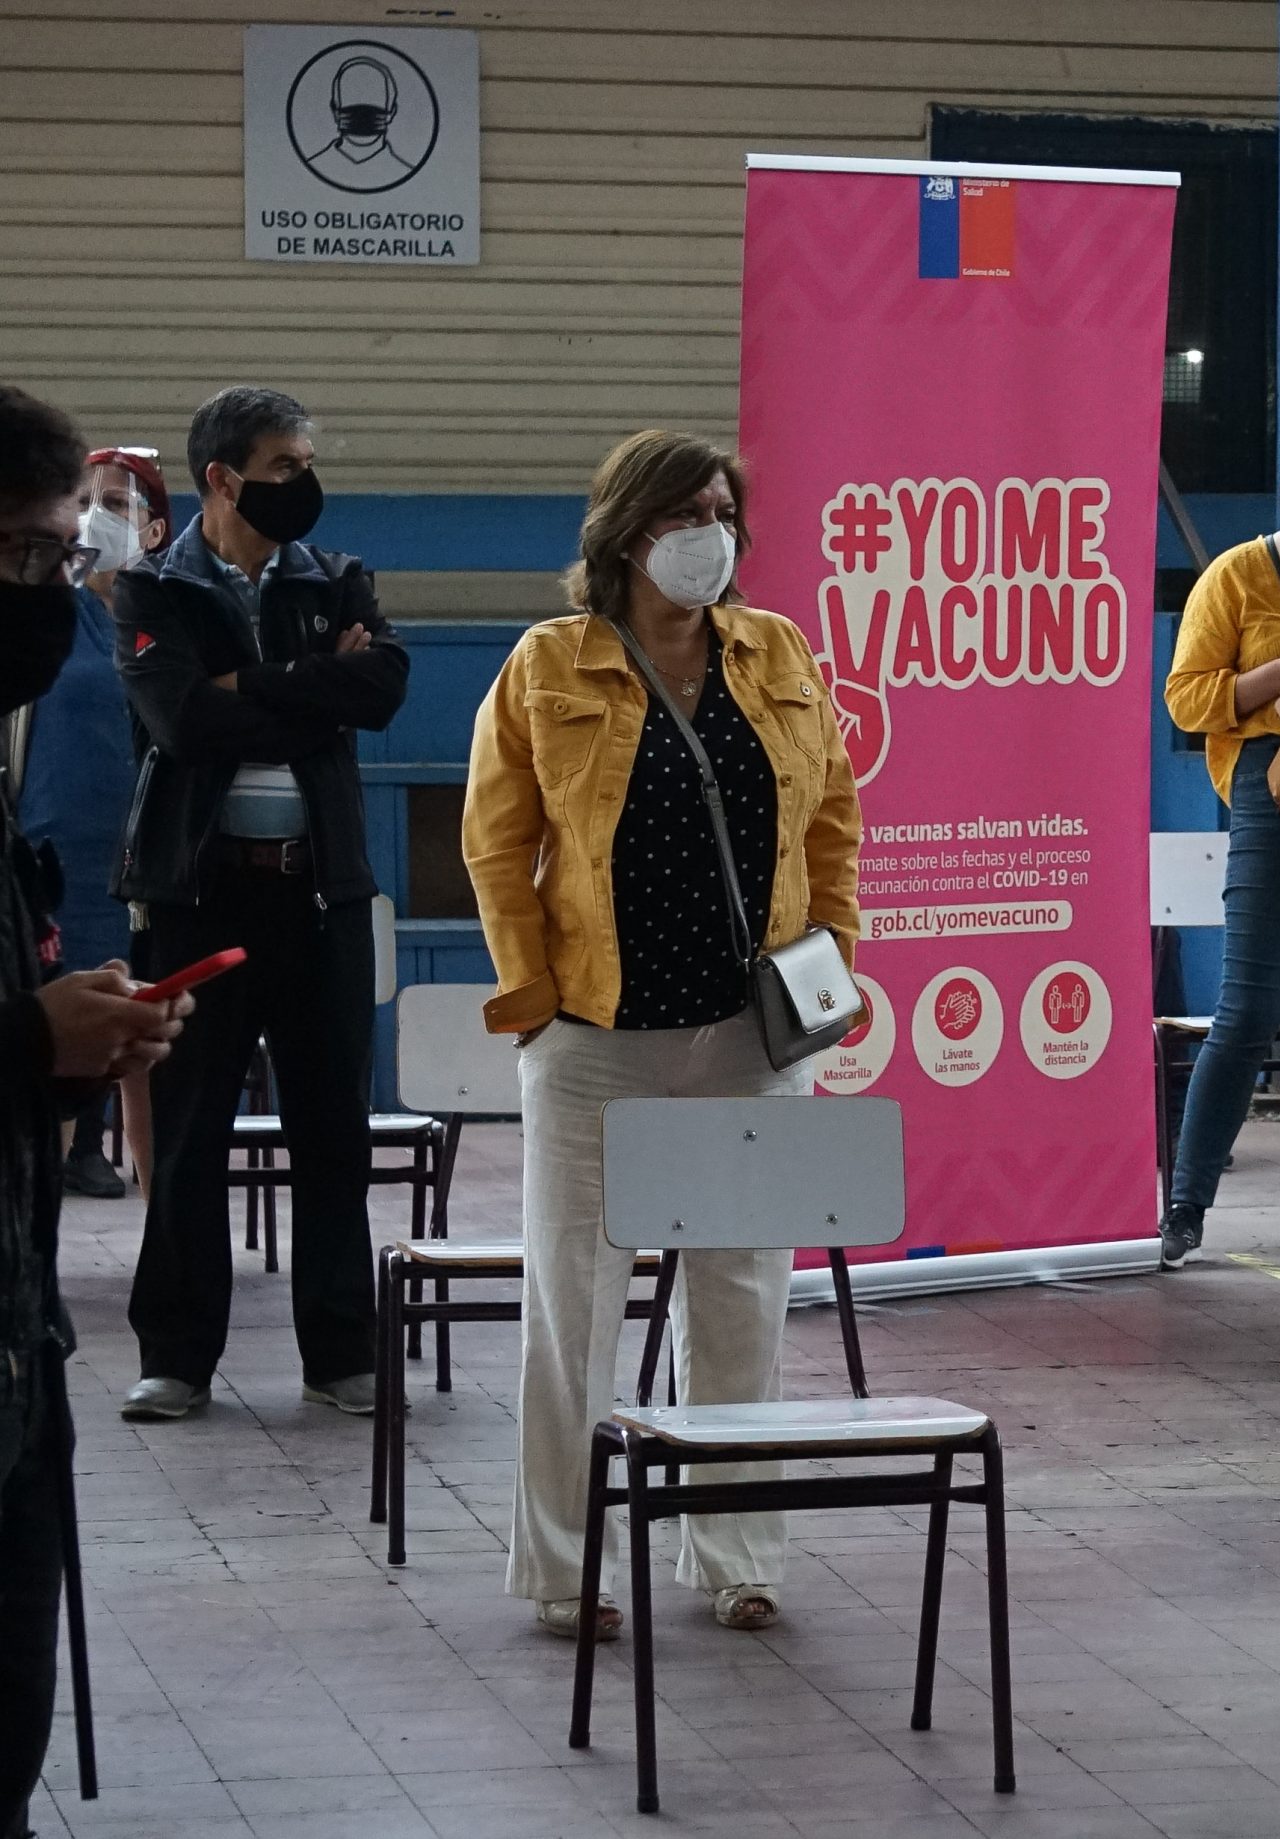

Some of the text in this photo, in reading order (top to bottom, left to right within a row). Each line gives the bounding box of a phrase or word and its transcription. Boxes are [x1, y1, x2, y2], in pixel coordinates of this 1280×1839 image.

[261, 210, 464, 231] USO OBLIGATORIO
[277, 237, 456, 257] DE MASCARILLA
[1001, 486, 1104, 580] ME
[825, 582, 1121, 688] VACUNO
[869, 823, 953, 843] vacunas
[957, 815, 1022, 840] salvan
[1027, 813, 1088, 837] vidas.
[901, 853, 938, 870] sobre
[941, 851, 959, 869] las
[962, 850, 1005, 867] fechas
[1008, 852, 1017, 869] y
[1020, 848, 1033, 865] el
[1036, 849, 1091, 868] proceso
[857, 869, 1088, 895] acunación contra el COVID-19 en
[870, 906, 1059, 938] gob.cl/yomevacuno
[1080, 1040, 1089, 1051] la
[839, 1055, 857, 1067] Usa
[935, 1061, 980, 1073] las manos
[1044, 1053, 1086, 1065] distancia
[823, 1068, 872, 1081] Mascarilla
